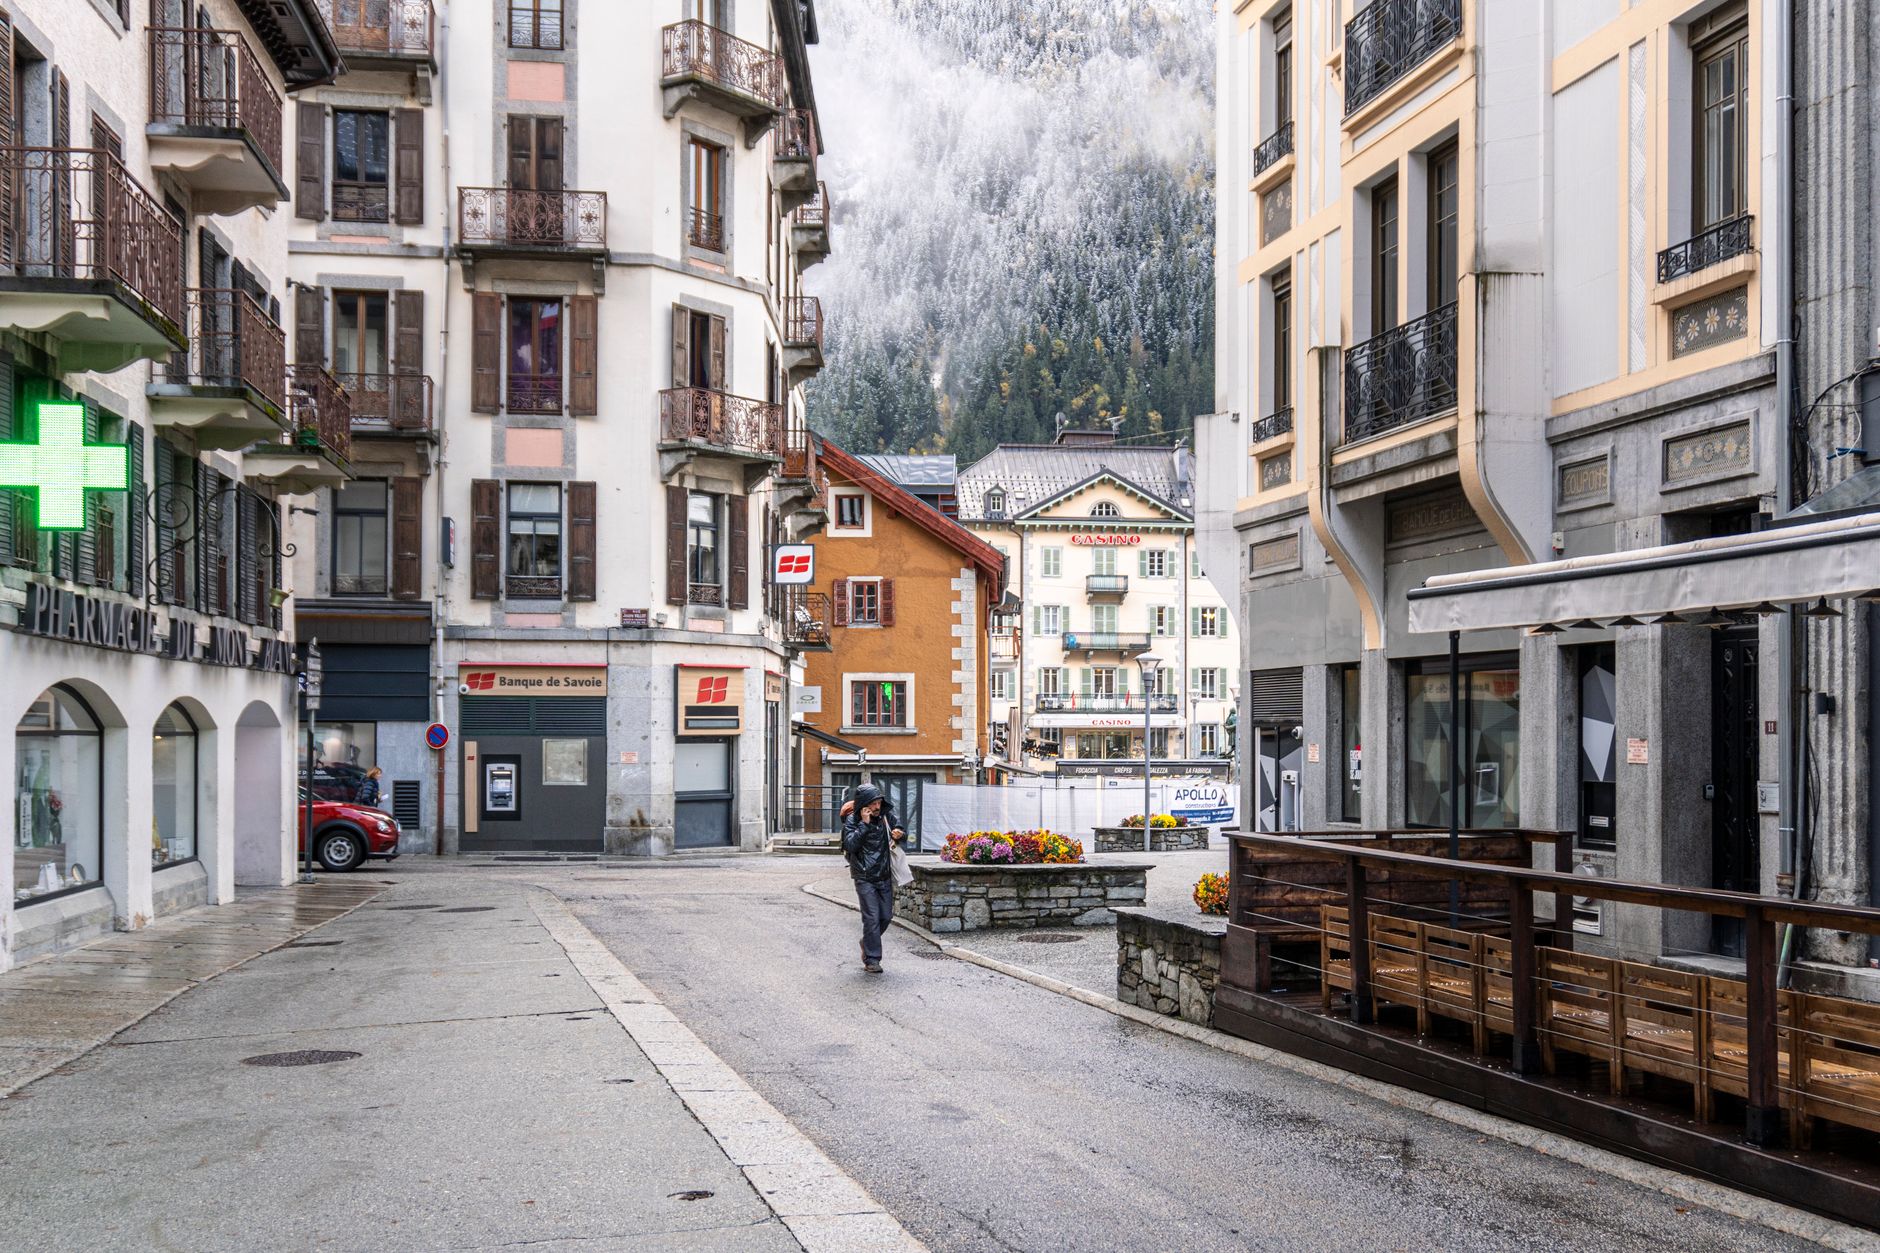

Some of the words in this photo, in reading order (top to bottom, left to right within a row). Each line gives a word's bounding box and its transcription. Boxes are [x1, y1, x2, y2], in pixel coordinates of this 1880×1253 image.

[1564, 466, 1608, 496] COUPONS
[1071, 534, 1141, 545] CASINO
[29, 582, 158, 655] PHARMACIE
[499, 677, 543, 689] Banque
[546, 677, 560, 687] de
[564, 677, 602, 687] Savoie
[1114, 766, 1133, 774] CRÊPES
[1175, 789, 1218, 801] APOLLO
